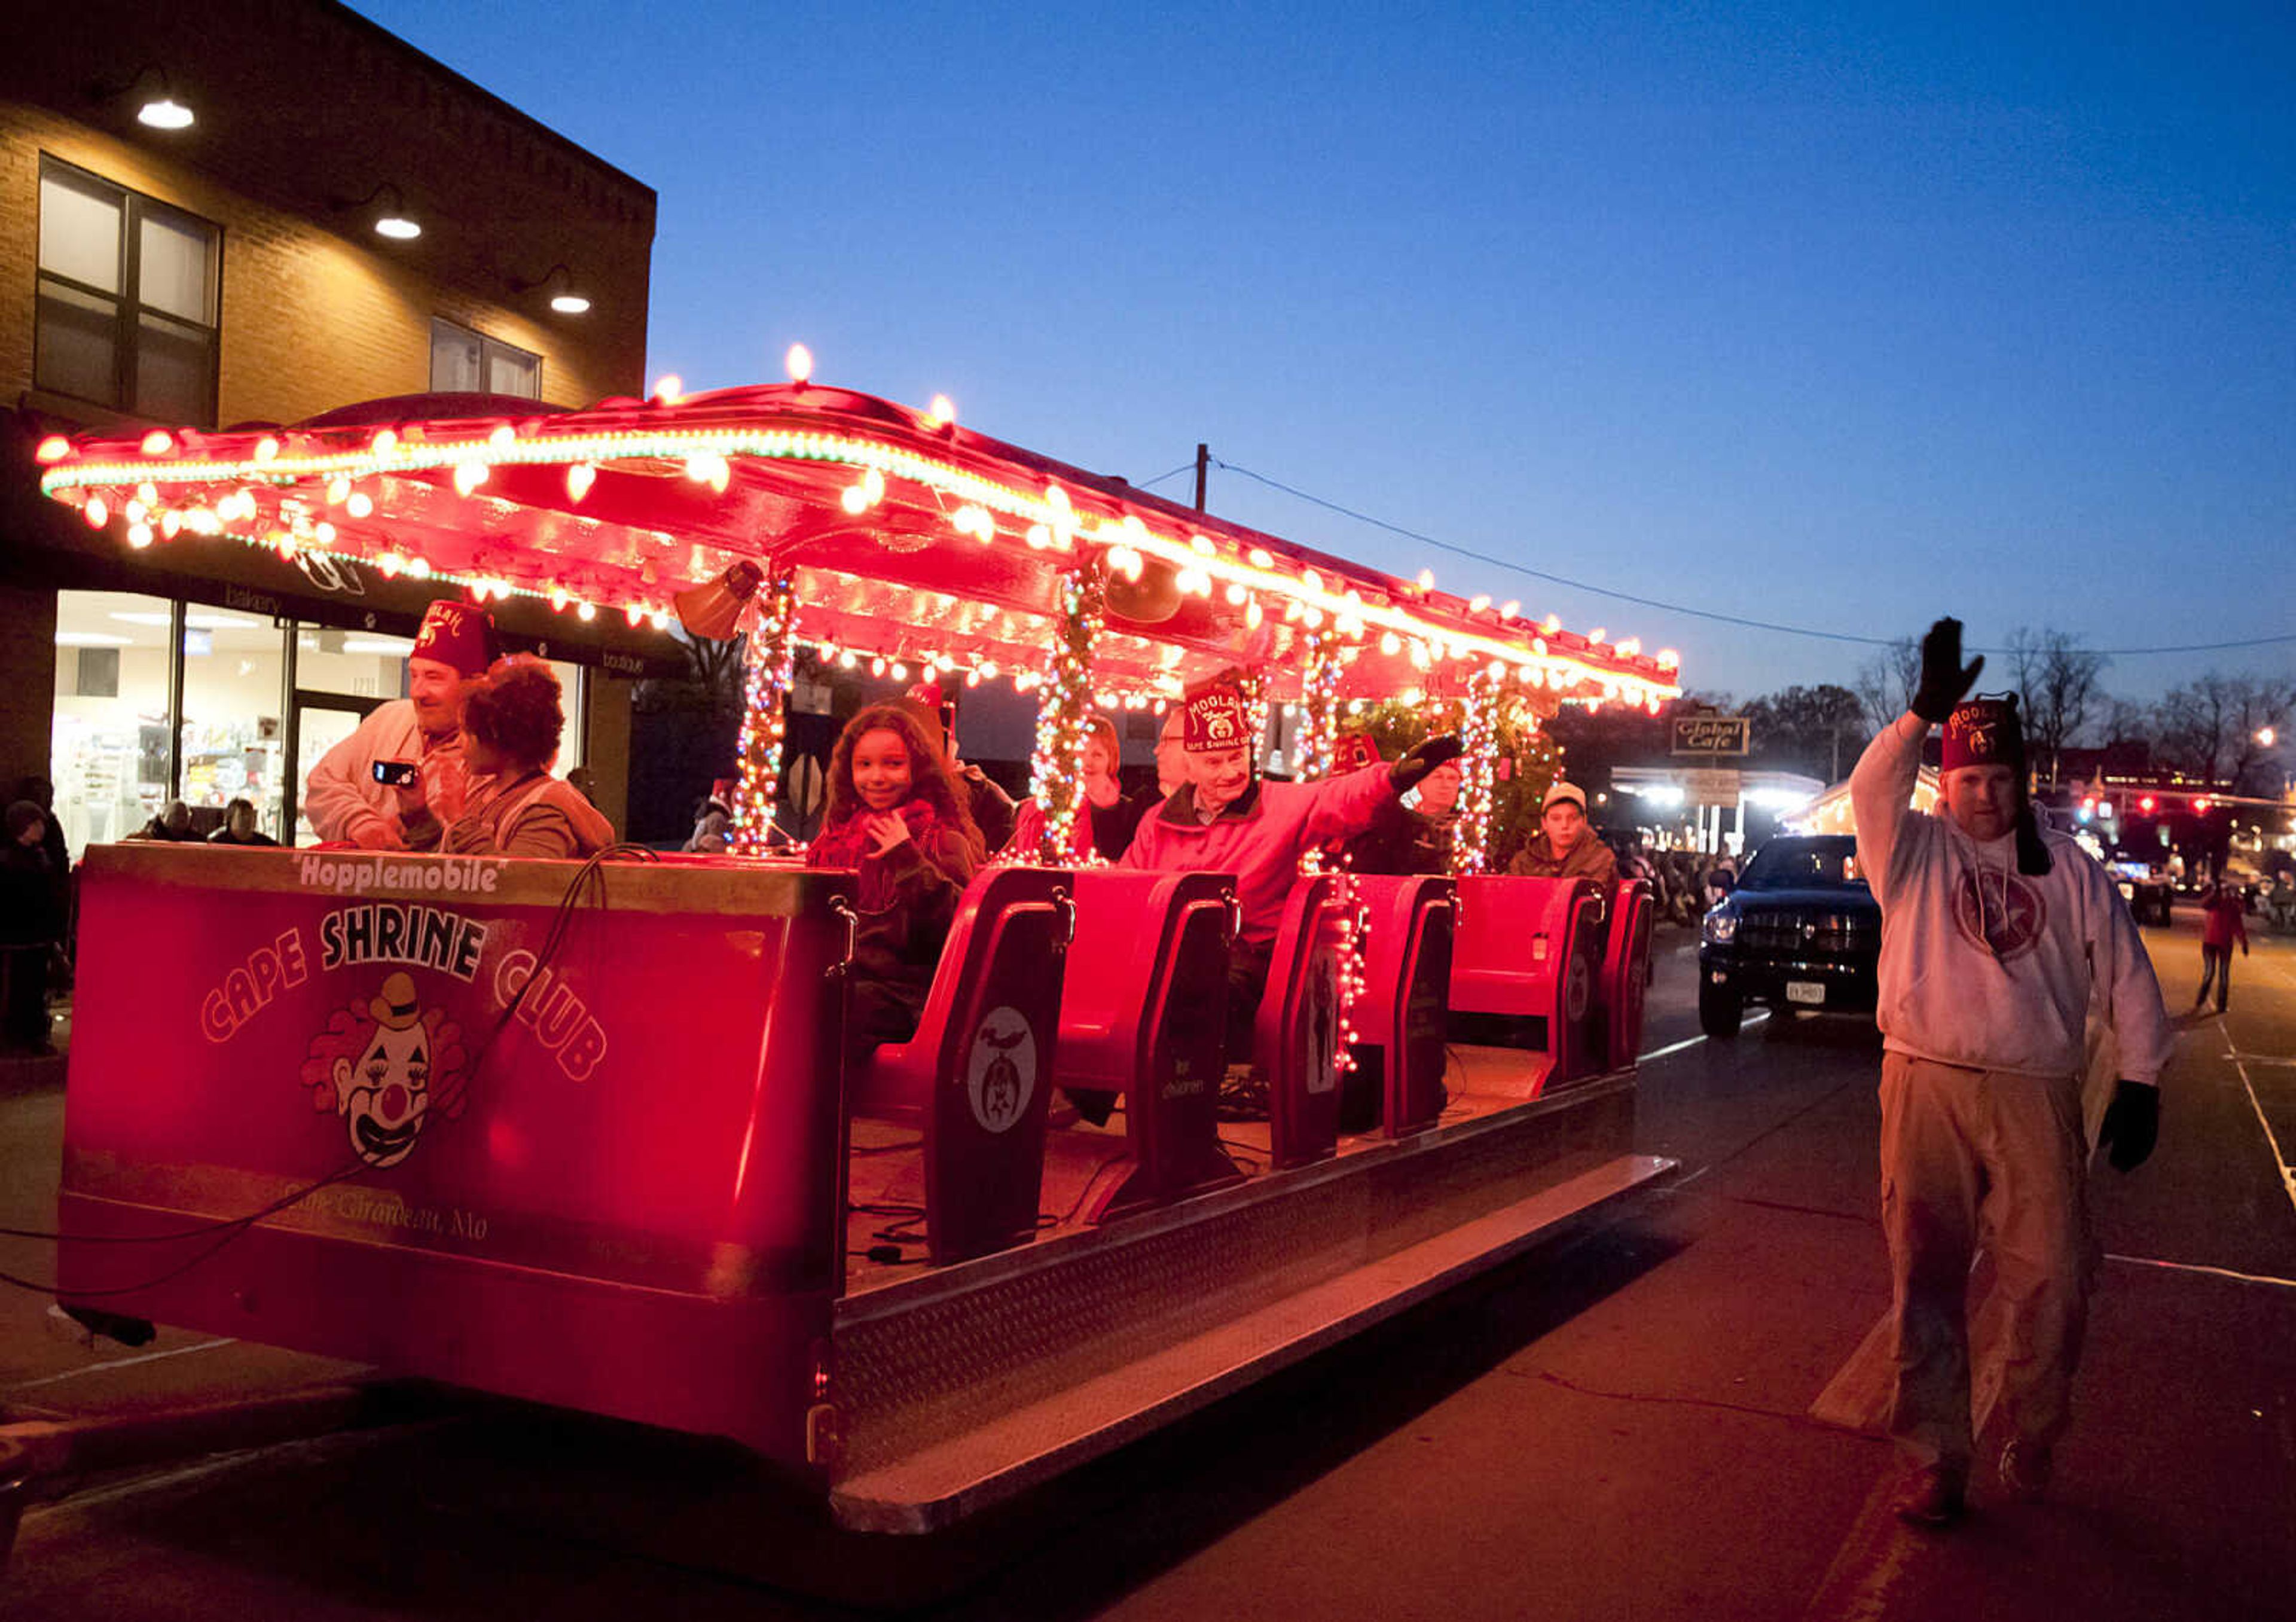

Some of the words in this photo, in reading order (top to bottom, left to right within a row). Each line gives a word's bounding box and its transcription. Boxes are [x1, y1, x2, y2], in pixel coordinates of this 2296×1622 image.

[1678, 722, 1741, 735] Global
[1687, 736, 1732, 749] Cafe
[201, 927, 308, 1043] CAPE
[320, 903, 487, 984] SHRINE
[494, 949, 607, 1081] CLUB
[450, 1208, 488, 1242] Mo
